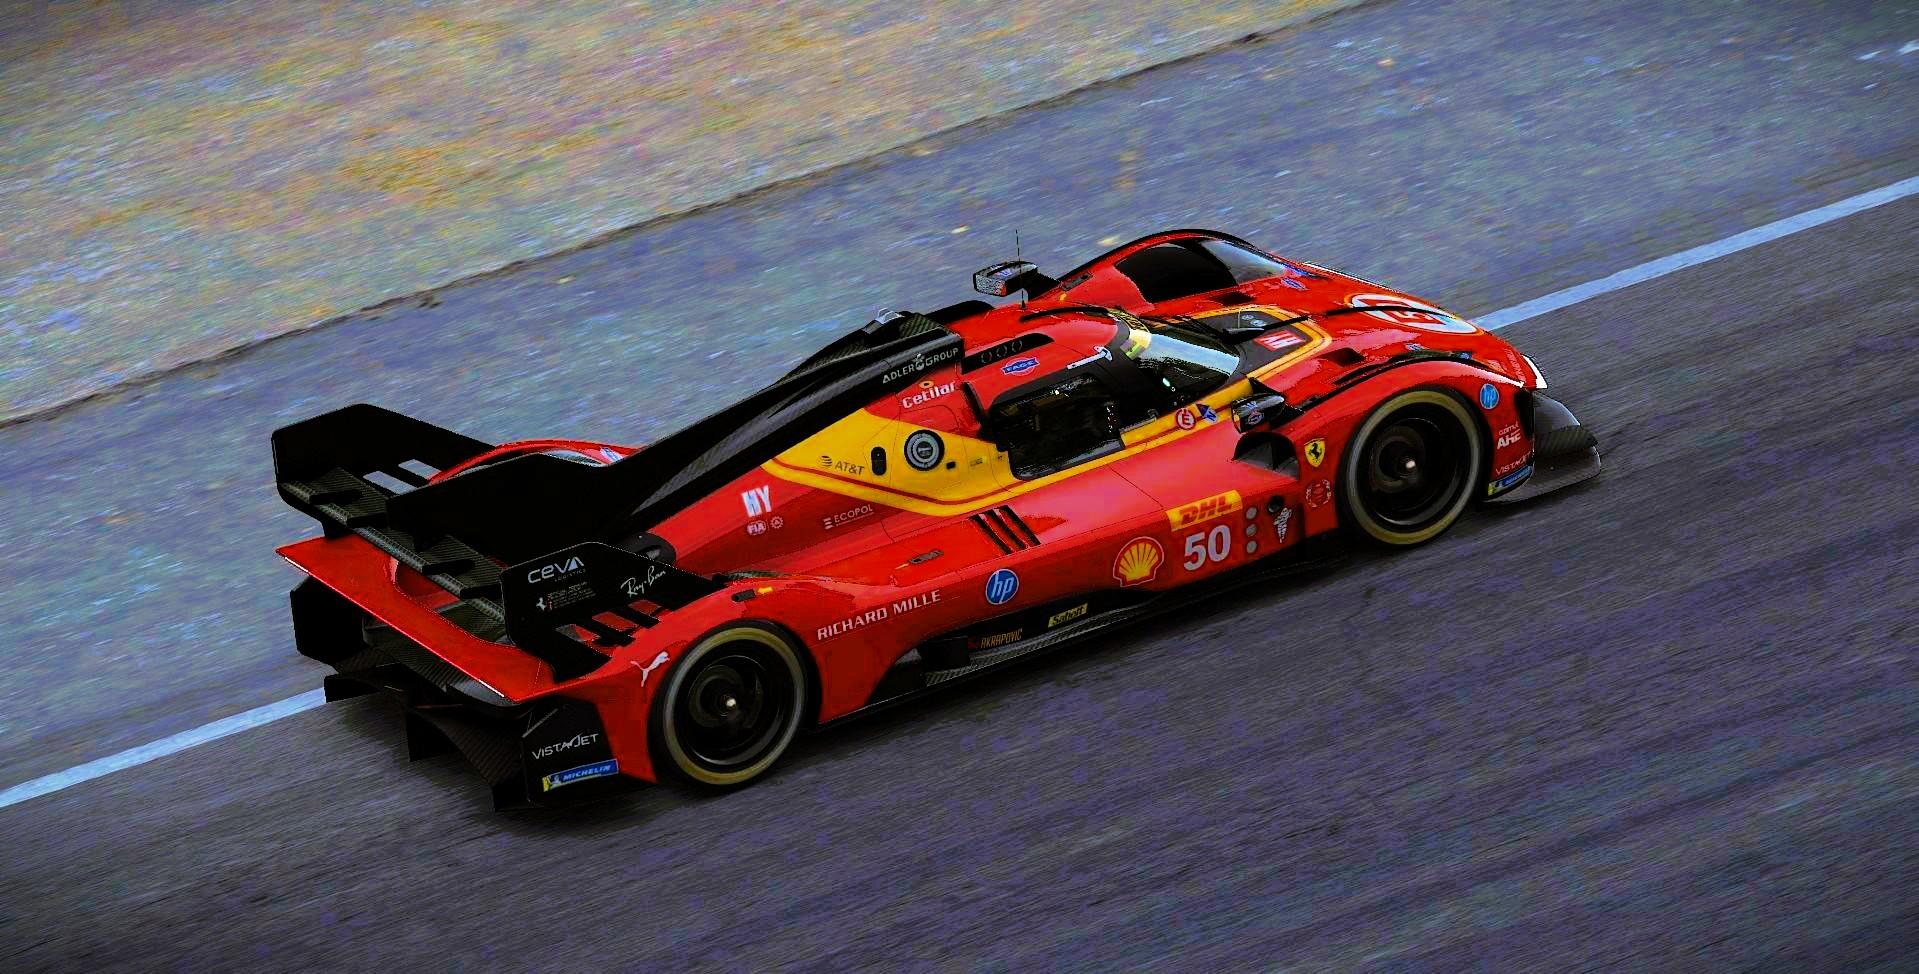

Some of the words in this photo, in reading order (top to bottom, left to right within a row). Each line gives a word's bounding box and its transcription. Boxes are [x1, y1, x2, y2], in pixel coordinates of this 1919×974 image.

[882, 366, 914, 385] ADLER
[925, 347, 959, 368] GROUP
[834, 460, 865, 476] AT&T
[741, 485, 773, 518] HY
[833, 503, 874, 524] ECOPOL
[1179, 495, 1233, 525] DHL
[747, 521, 766, 536] FIA
[1183, 524, 1231, 571] 50
[527, 556, 585, 584] CEVA
[619, 565, 667, 598] Ray-Ban
[992, 570, 1014, 604] hp
[816, 607, 888, 641] RICHARD
[893, 588, 942, 615] MILLE
[532, 731, 600, 760] VISTAJET
[562, 764, 611, 782] MICHELIN
